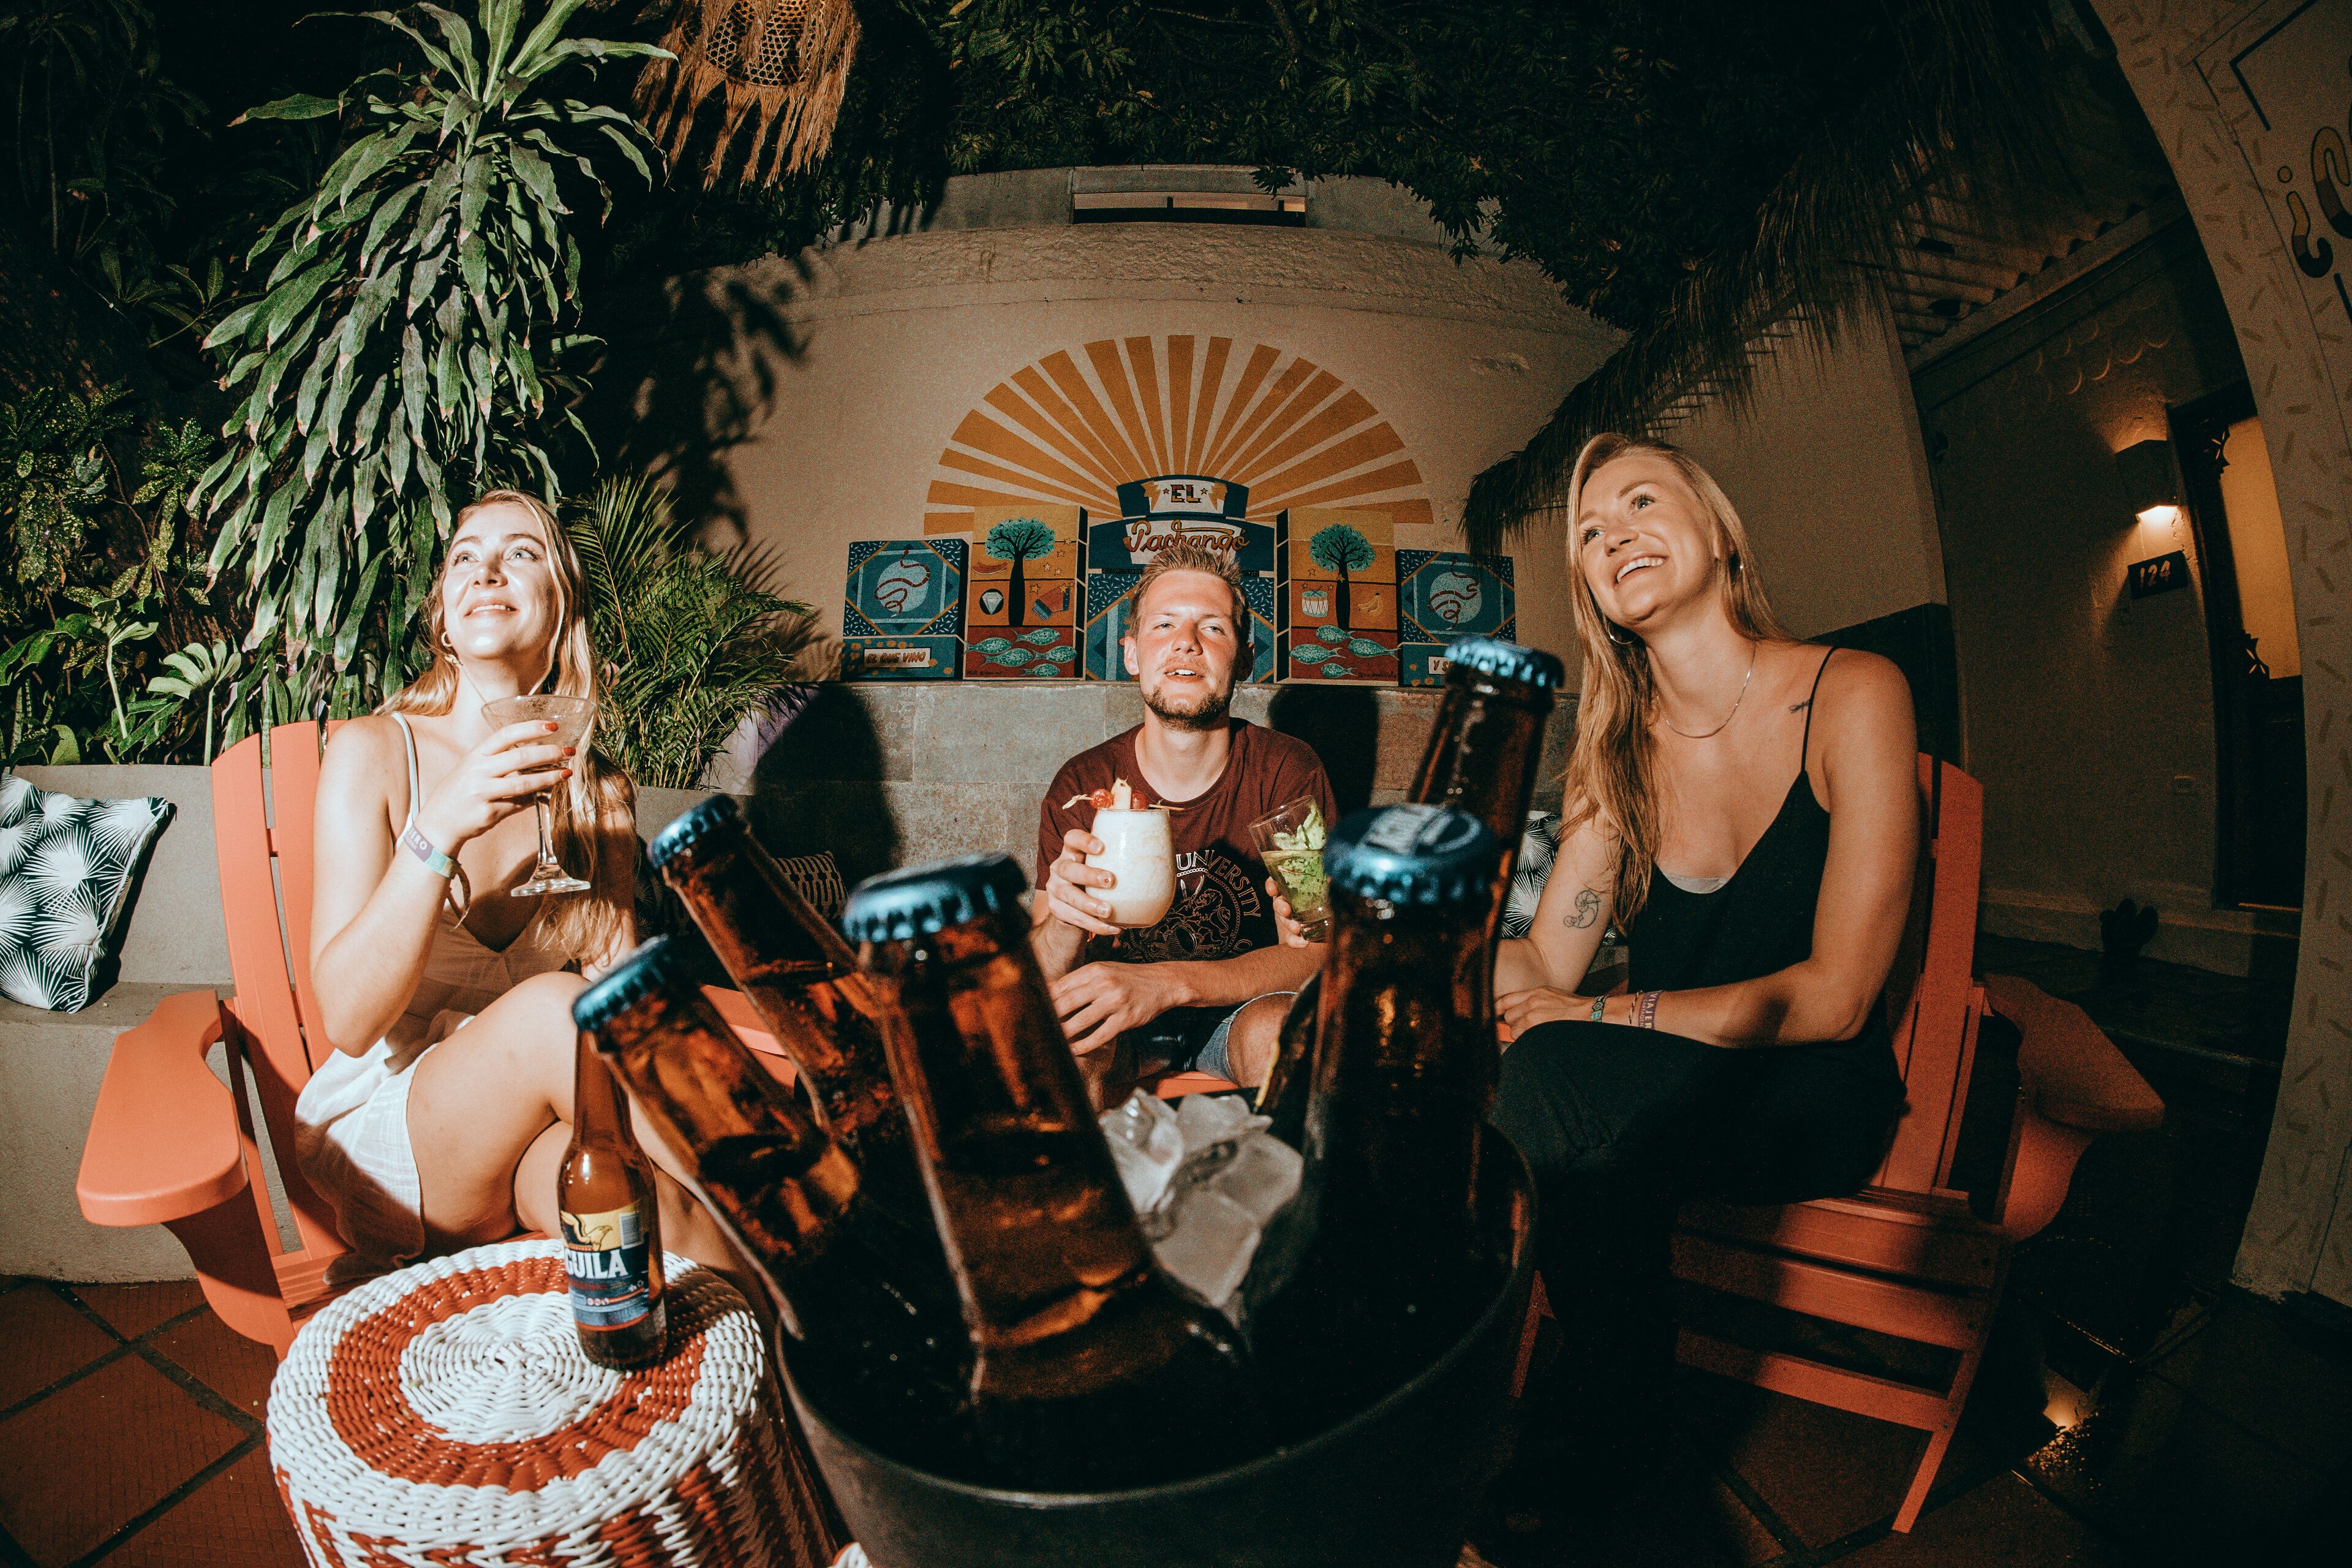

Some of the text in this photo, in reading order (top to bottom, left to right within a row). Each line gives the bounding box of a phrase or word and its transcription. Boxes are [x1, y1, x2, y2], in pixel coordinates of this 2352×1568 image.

[1170, 484, 1201, 503] EL
[2139, 560, 2171, 588] 124
[880, 652, 901, 663] QUE
[902, 652, 926, 663] VINO
[1176, 850, 1261, 918] UNVERSITY
[1645, 993, 1658, 1029] VIAJER
[564, 1247, 629, 1280] GUILA
